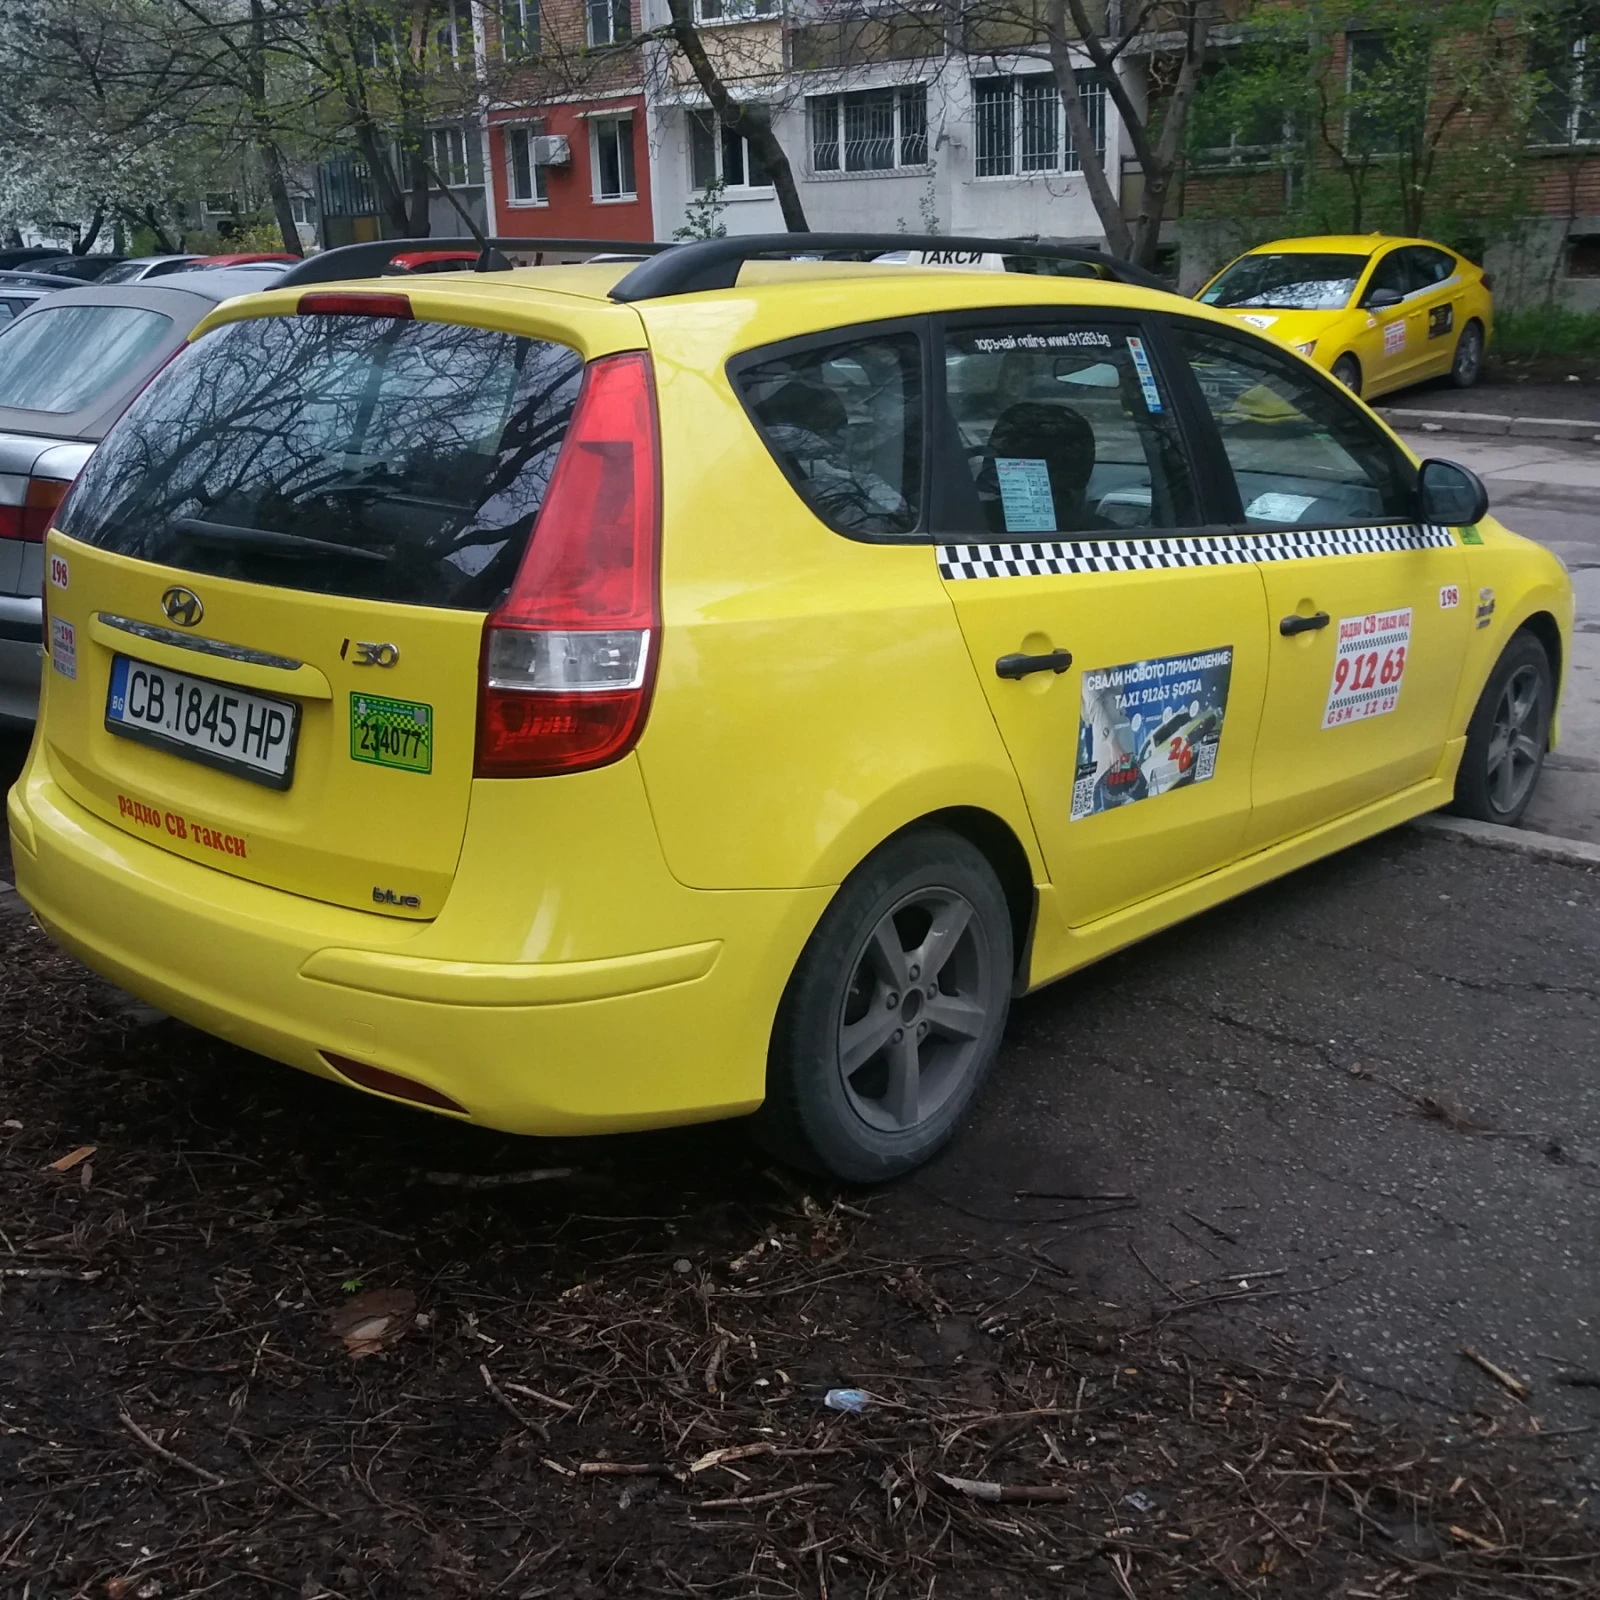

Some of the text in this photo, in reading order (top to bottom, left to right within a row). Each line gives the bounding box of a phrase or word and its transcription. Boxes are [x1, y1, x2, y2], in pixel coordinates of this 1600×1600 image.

[920, 250, 983, 265] ТАКСИ
[1047, 331, 1112, 348] www.91263.bg
[52, 559, 68, 587] 198
[1440, 588, 1458, 607] 198
[1087, 671, 1124, 691] СВАЛИ
[1124, 663, 1165, 685] НОВОТО
[112, 695, 124, 710] BG
[1114, 690, 1141, 710] TAXI
[1142, 685, 1170, 704] 91263
[360, 721, 422, 759] 234077
